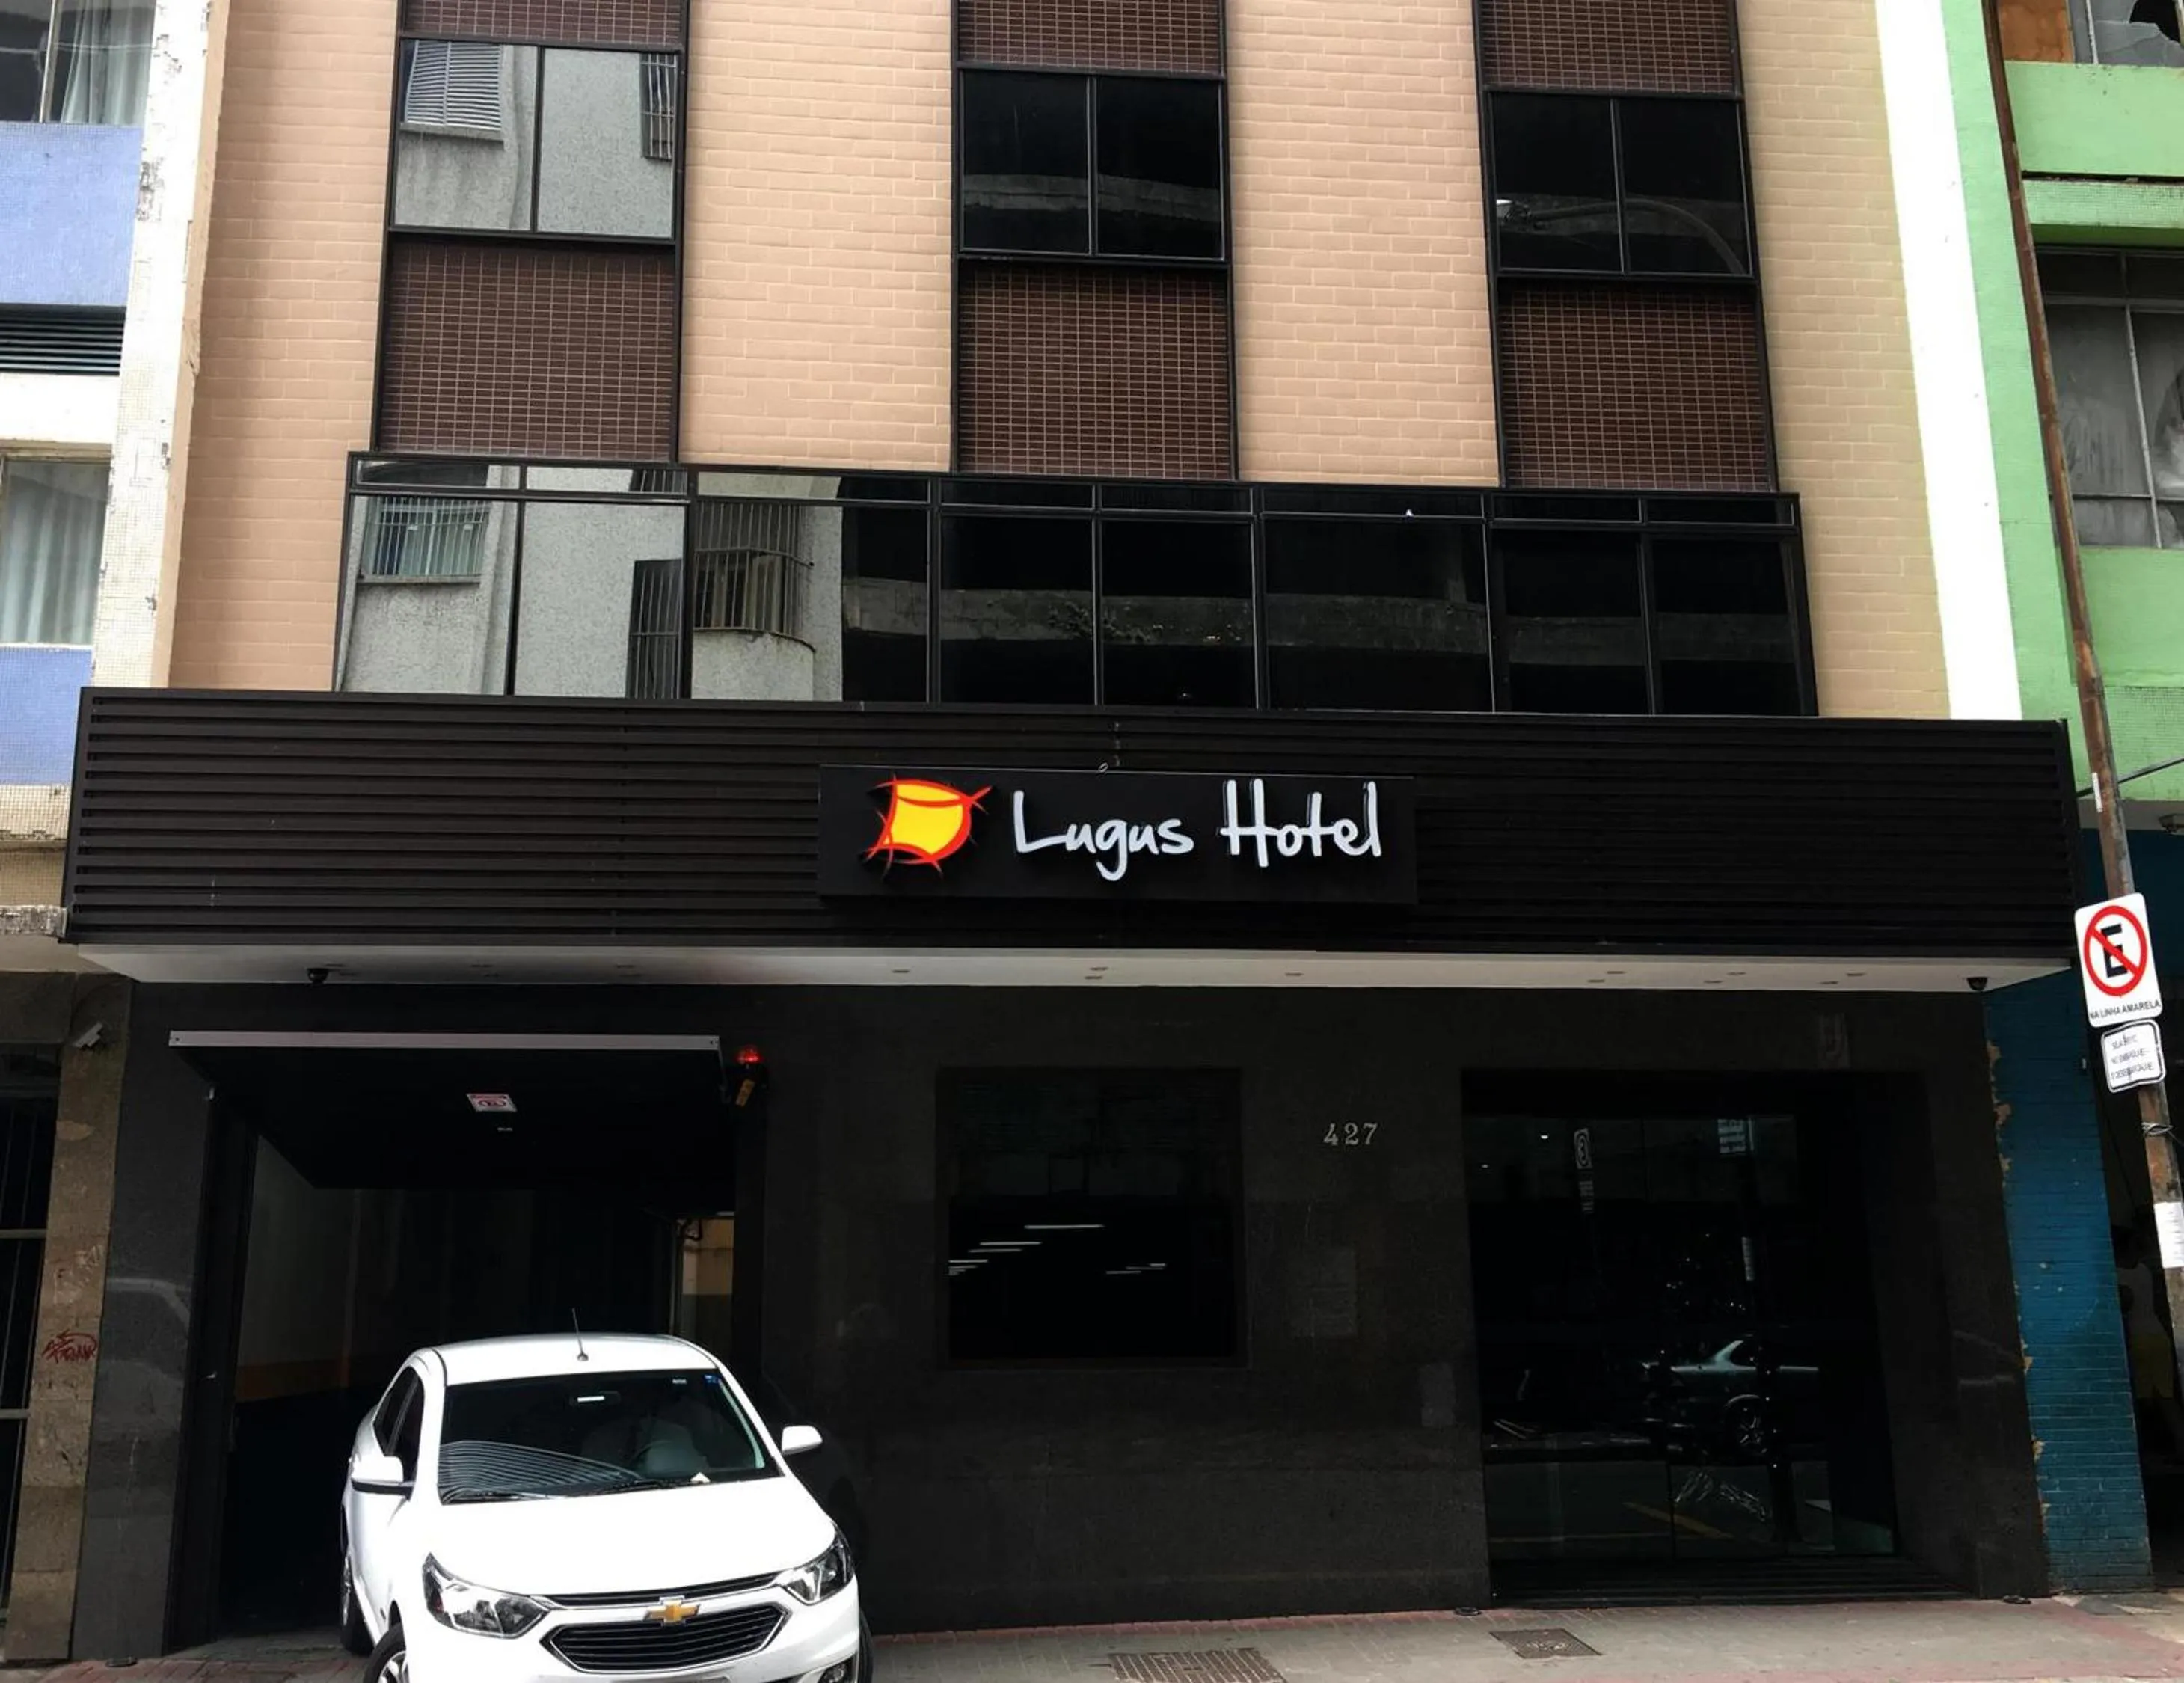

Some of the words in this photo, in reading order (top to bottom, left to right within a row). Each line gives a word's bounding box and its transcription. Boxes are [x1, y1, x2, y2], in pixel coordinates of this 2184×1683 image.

[1013, 791, 1194, 880] Lugus
[1221, 779, 1382, 868] Hotel
[2101, 923, 2128, 978] E
[2099, 1006, 2120, 1018] LINHA
[2122, 999, 2161, 1013] AMARELA
[1322, 1122, 1378, 1146] 427
